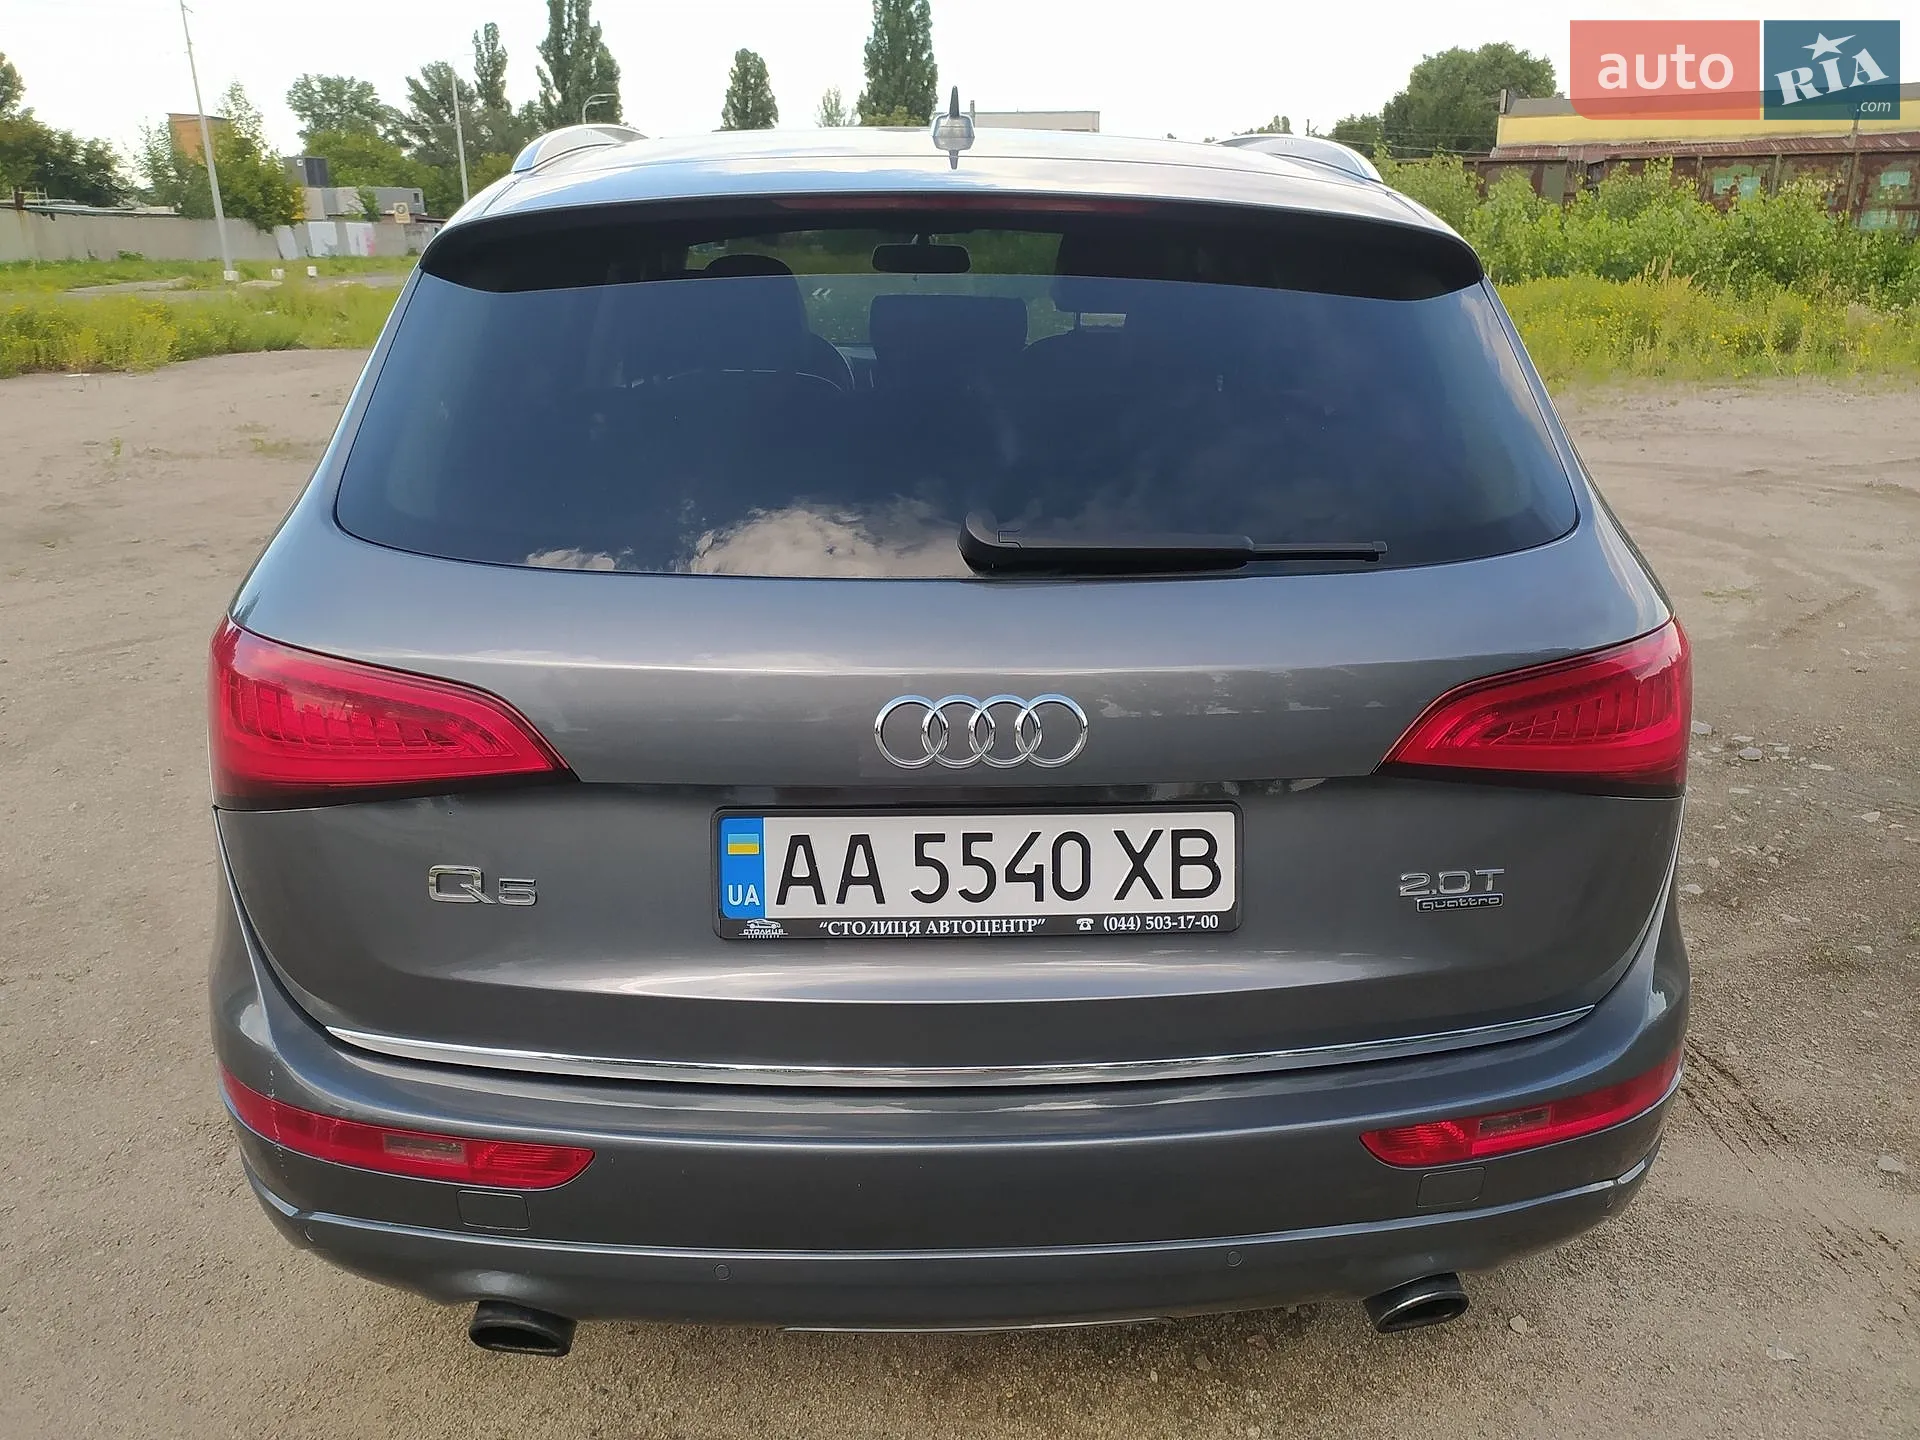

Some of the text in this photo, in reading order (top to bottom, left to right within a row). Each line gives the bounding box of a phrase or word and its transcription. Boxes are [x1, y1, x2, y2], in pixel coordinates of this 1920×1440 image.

[910, 831, 1092, 903] 5540
[428, 864, 537, 906] Q5
[1400, 868, 1504, 896] 2.0T
[727, 884, 760, 907] UA
[1422, 897, 1500, 910] quattro
[1103, 915, 1141, 931] (044)
[1146, 915, 1219, 930] 503-17-00
